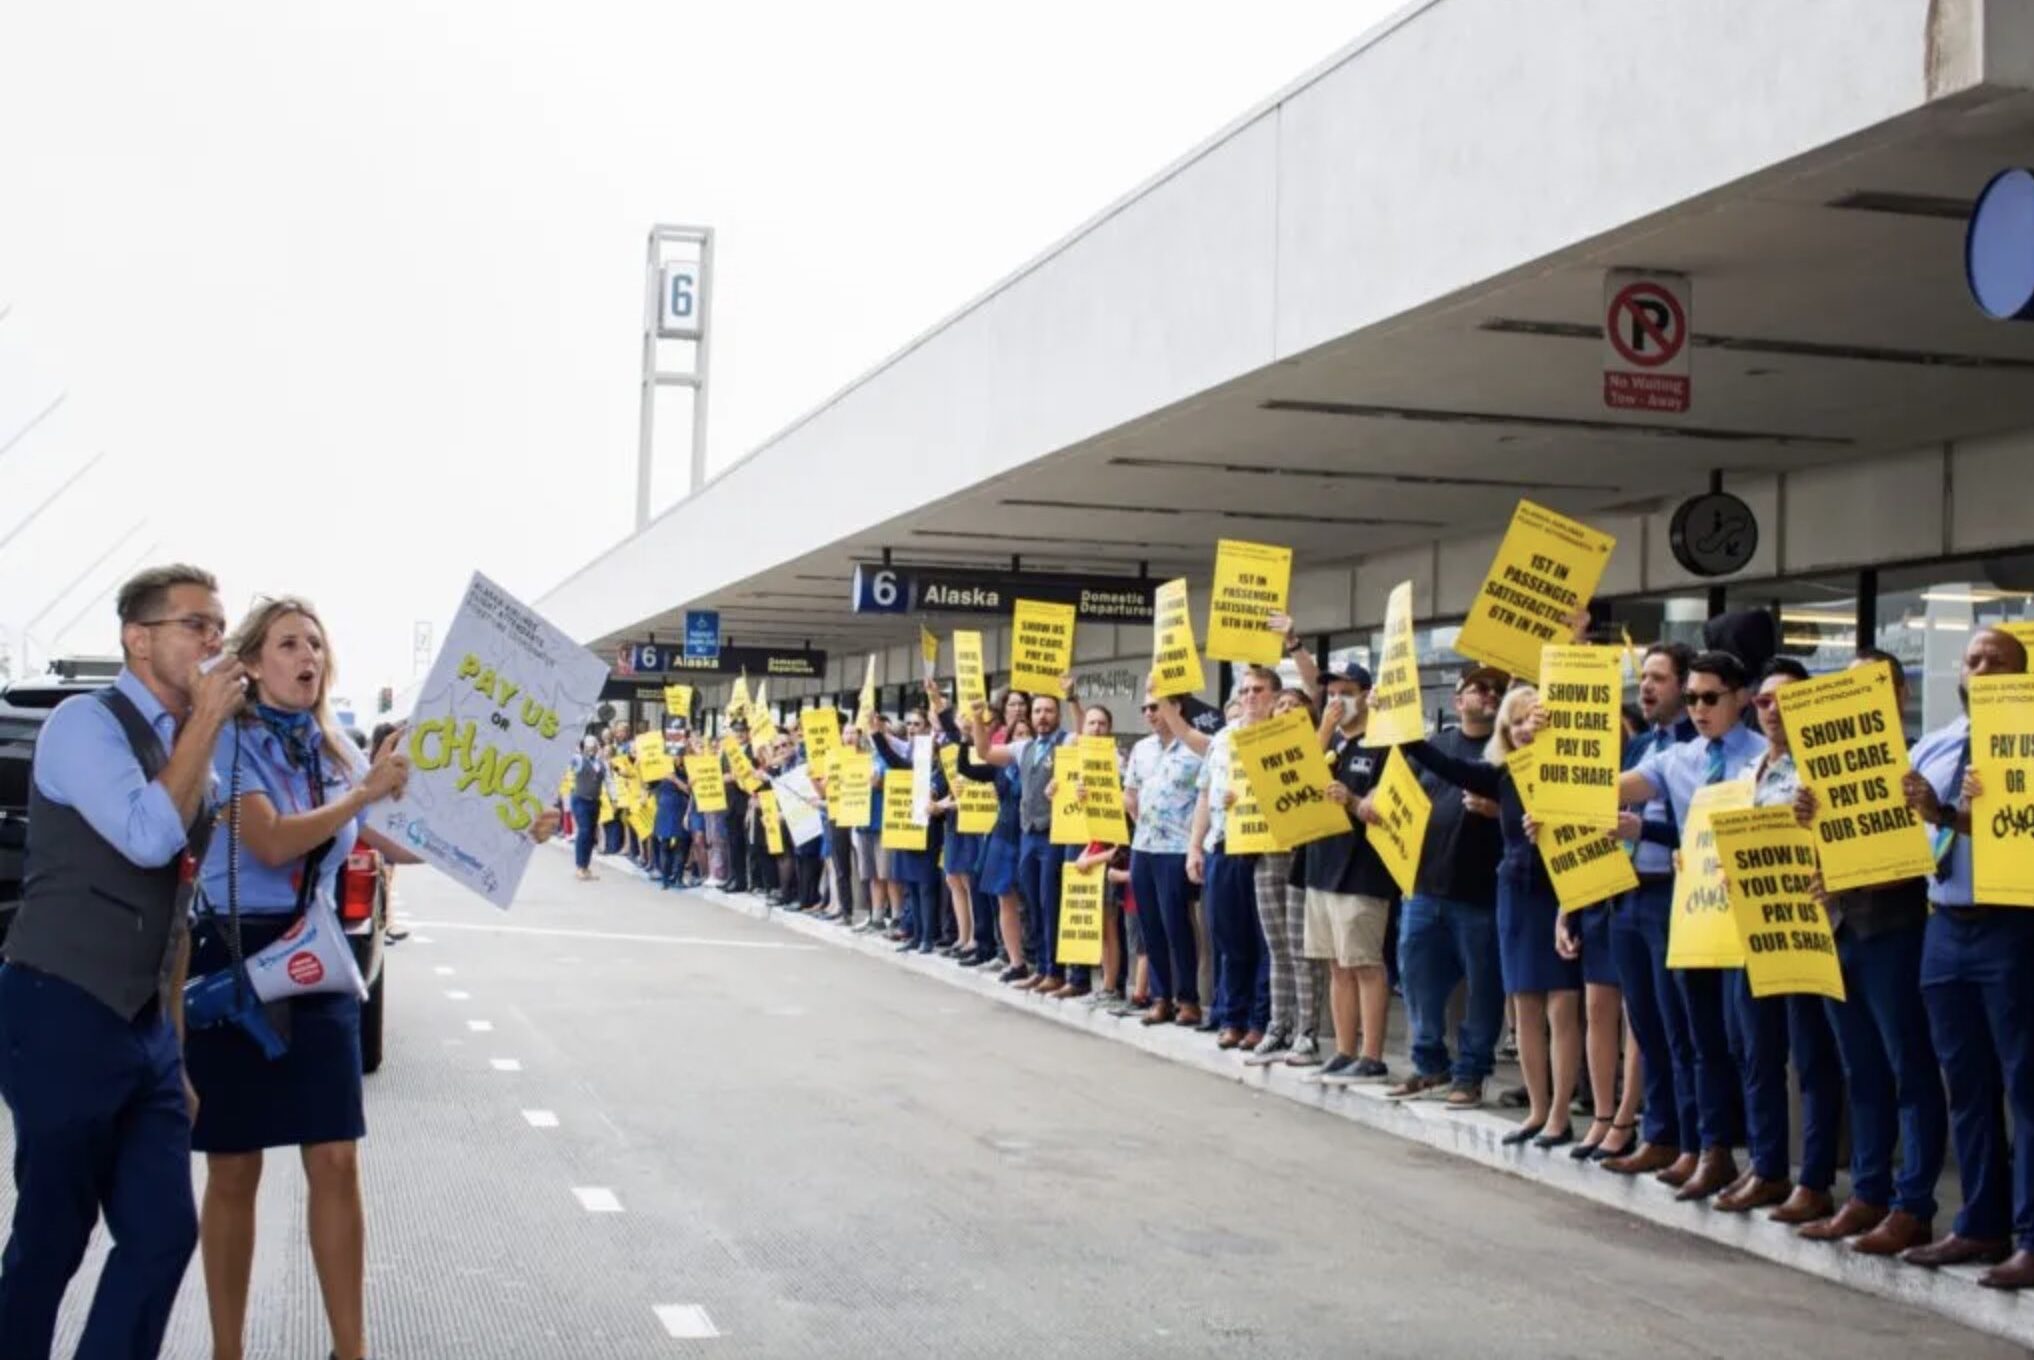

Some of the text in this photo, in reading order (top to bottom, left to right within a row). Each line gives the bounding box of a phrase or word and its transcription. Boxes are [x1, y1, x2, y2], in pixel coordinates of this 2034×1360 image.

[671, 274, 693, 317] 6
[1609, 374, 1683, 396] No Waiting
[1531, 554, 1570, 580] 1ST IN
[873, 570, 999, 607] 6 Alaska
[1081, 589, 1145, 605] Domestic
[1080, 601, 1154, 616] Departures
[1488, 605, 1558, 641] 6TH IN PAY
[641, 646, 657, 668] 6
[458, 653, 560, 739] PAY US
[1547, 683, 1611, 704] SHOW US
[1781, 677, 1855, 701] ALASKA AIRLINES
[1781, 685, 1873, 712] FLIGHT ATTENDANTS
[491, 712, 511, 732] OR
[1801, 709, 1886, 749] SHOW US
[1555, 737, 1601, 758] PAY US
[1990, 733, 2016, 758] PAY
[1260, 746, 1305, 771] PAY US
[1804, 752, 1842, 781] YOU
[410, 715, 543, 831] CHAOS
[1280, 769, 1299, 785] OR
[1540, 763, 1569, 783] OUR
[1571, 765, 1614, 787] SHARE
[2005, 768, 2025, 794] OR
[1828, 776, 1889, 809] PAY US
[1553, 824, 1577, 846] PAY
[1819, 804, 1918, 844] OUR SHARE
[1550, 836, 1620, 875] OUR SHARE
[1734, 845, 1793, 870] SHOW
[1738, 874, 1778, 898] YOU
[1762, 902, 1819, 923] PAY US
[1748, 932, 1789, 953] OUR
